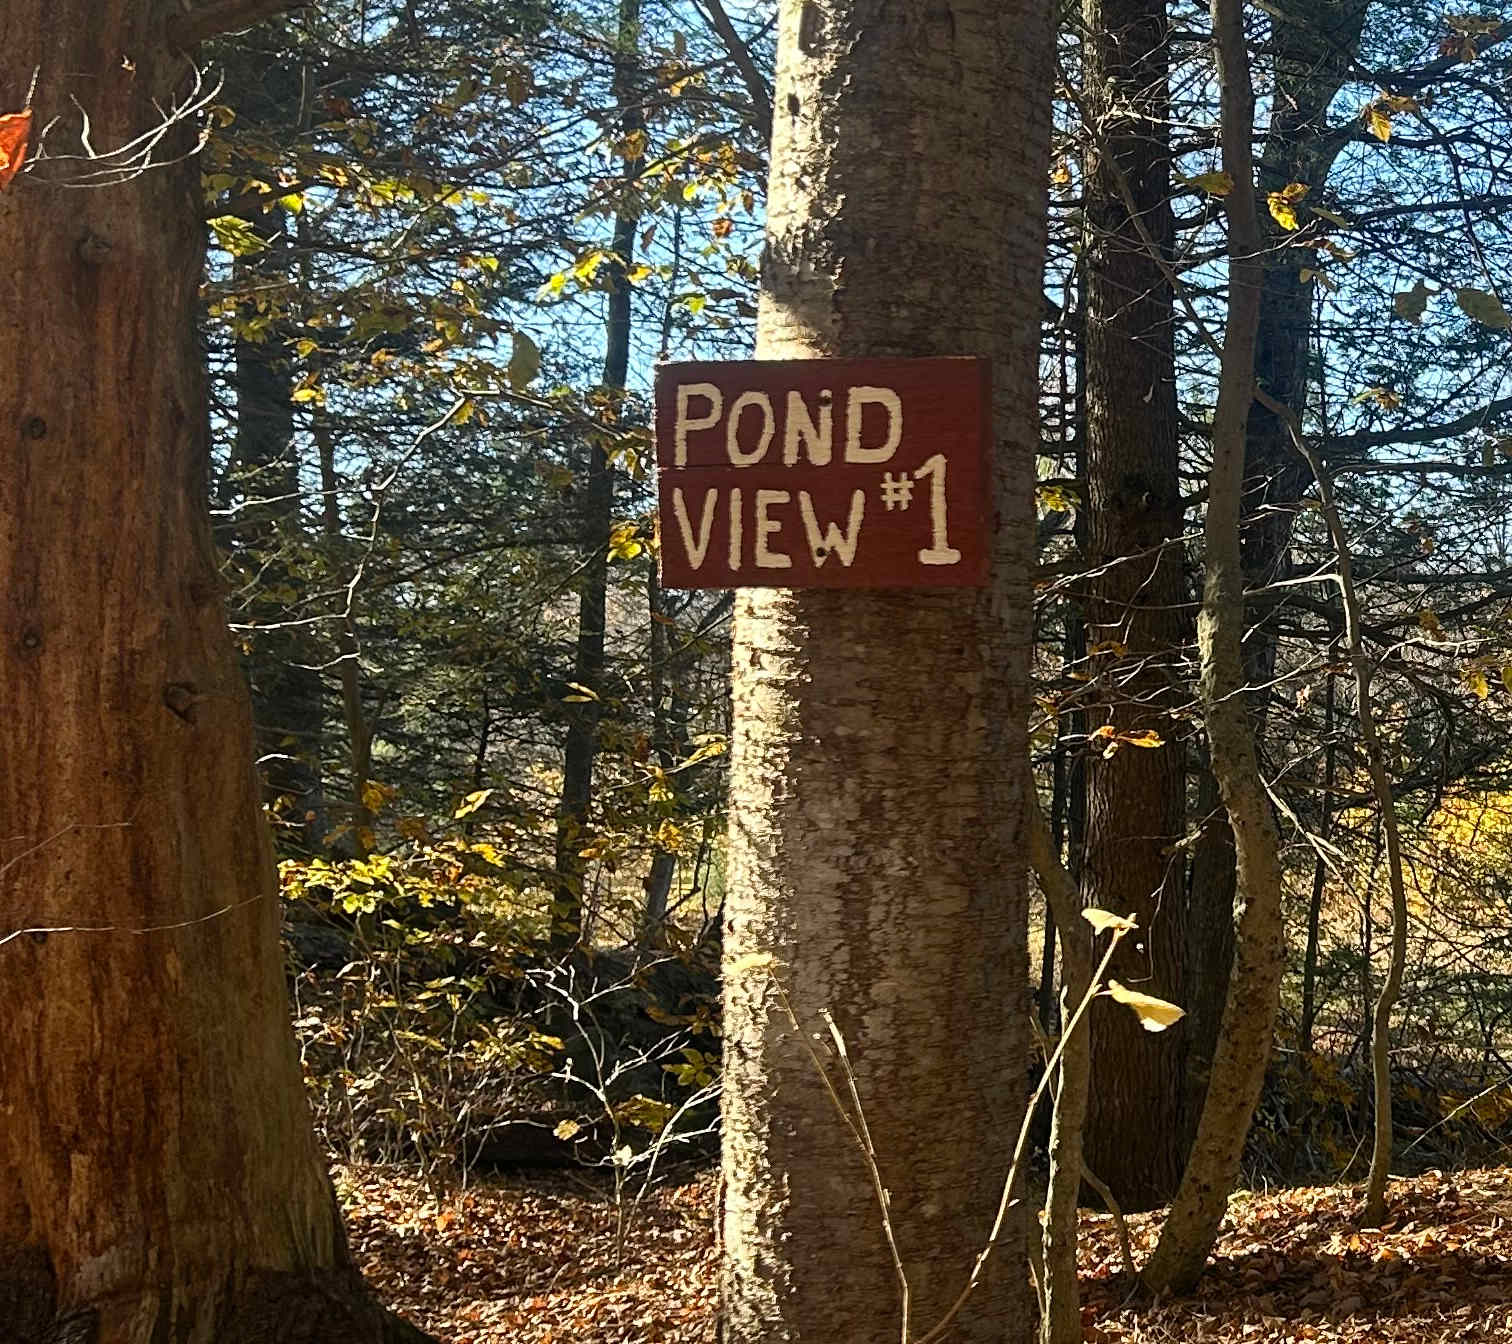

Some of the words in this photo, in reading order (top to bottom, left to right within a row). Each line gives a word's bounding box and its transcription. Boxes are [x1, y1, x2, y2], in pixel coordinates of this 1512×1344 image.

[674, 383, 903, 469] POND
[673, 488, 865, 571] VIEW
[880, 454, 961, 565] #1
